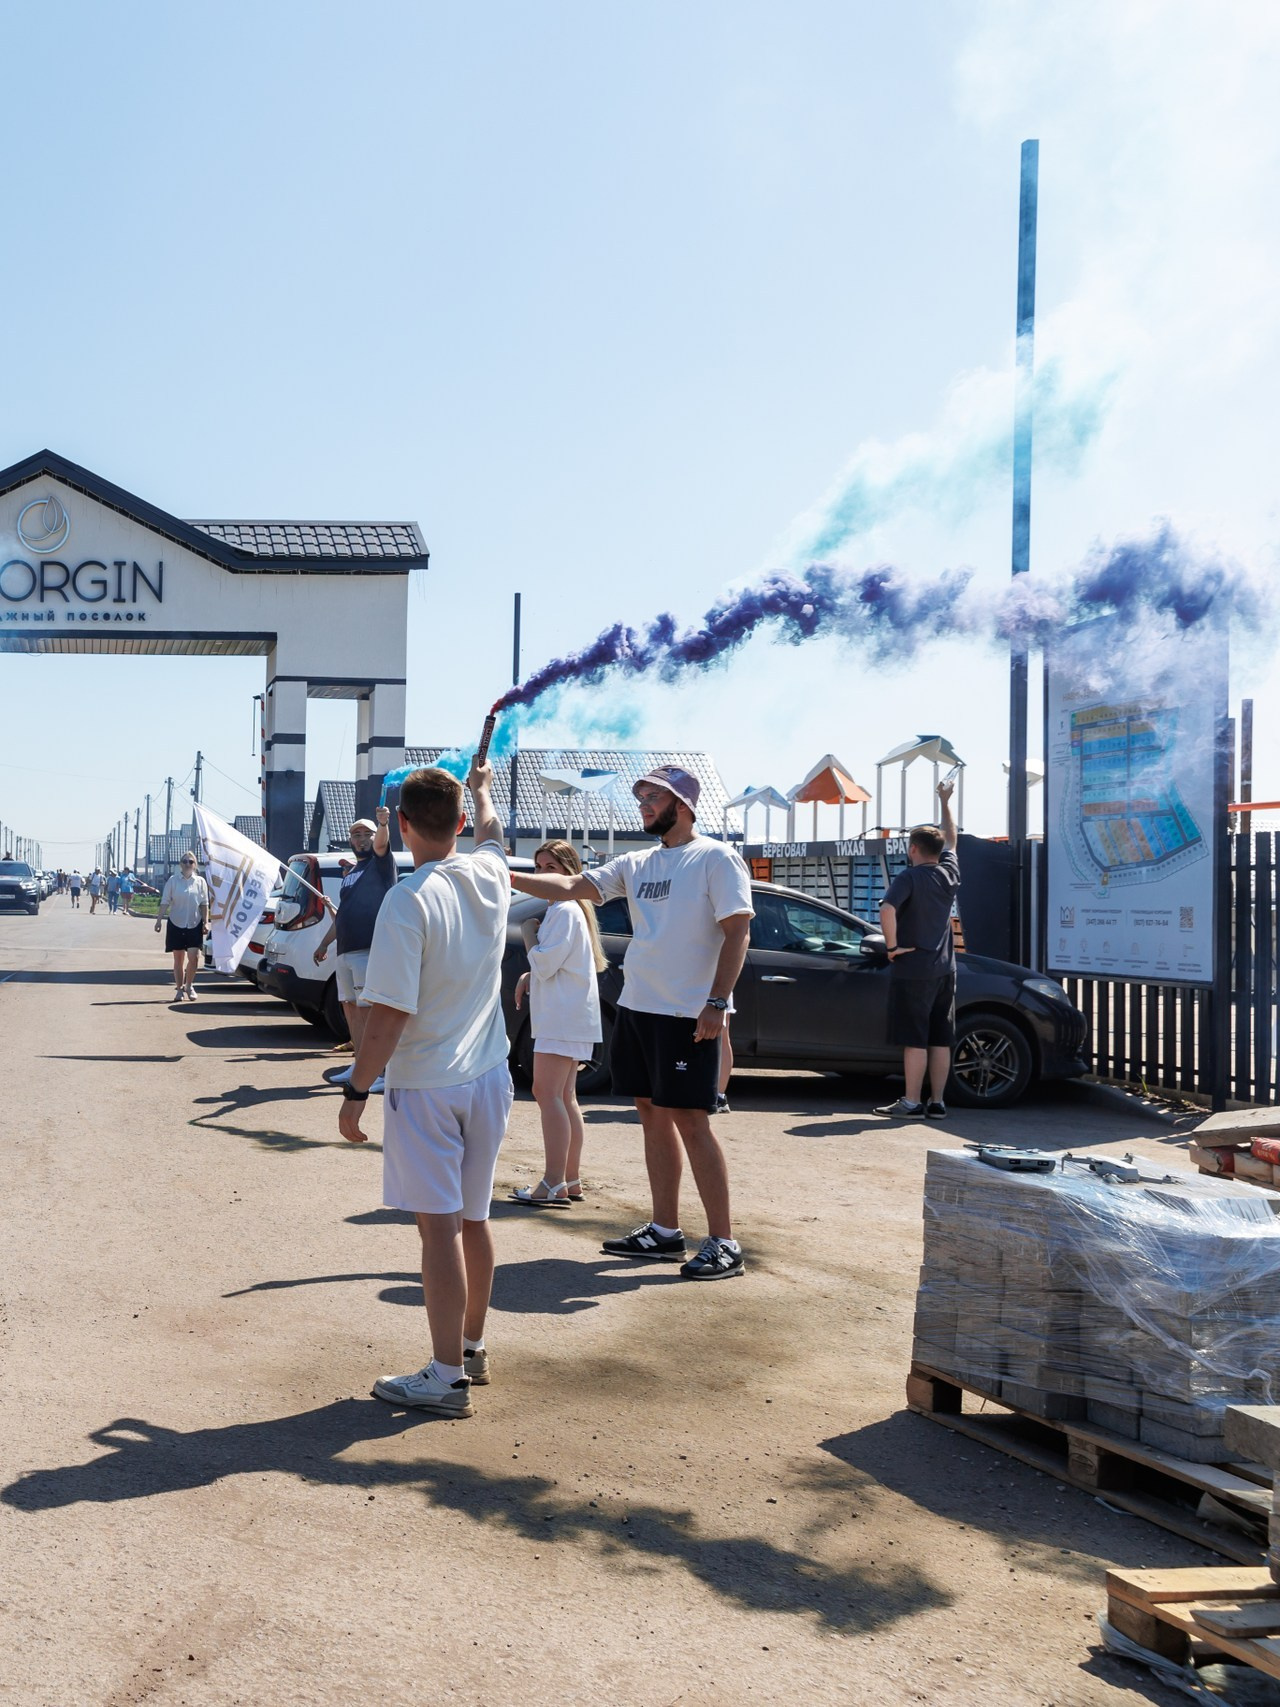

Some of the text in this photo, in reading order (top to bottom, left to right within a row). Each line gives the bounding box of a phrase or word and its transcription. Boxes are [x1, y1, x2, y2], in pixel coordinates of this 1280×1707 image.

[762, 843, 807, 858] БЕРЕГОВАЯ
[835, 840, 866, 856] ТИХАЯ
[636, 879, 672, 899] FRDM
